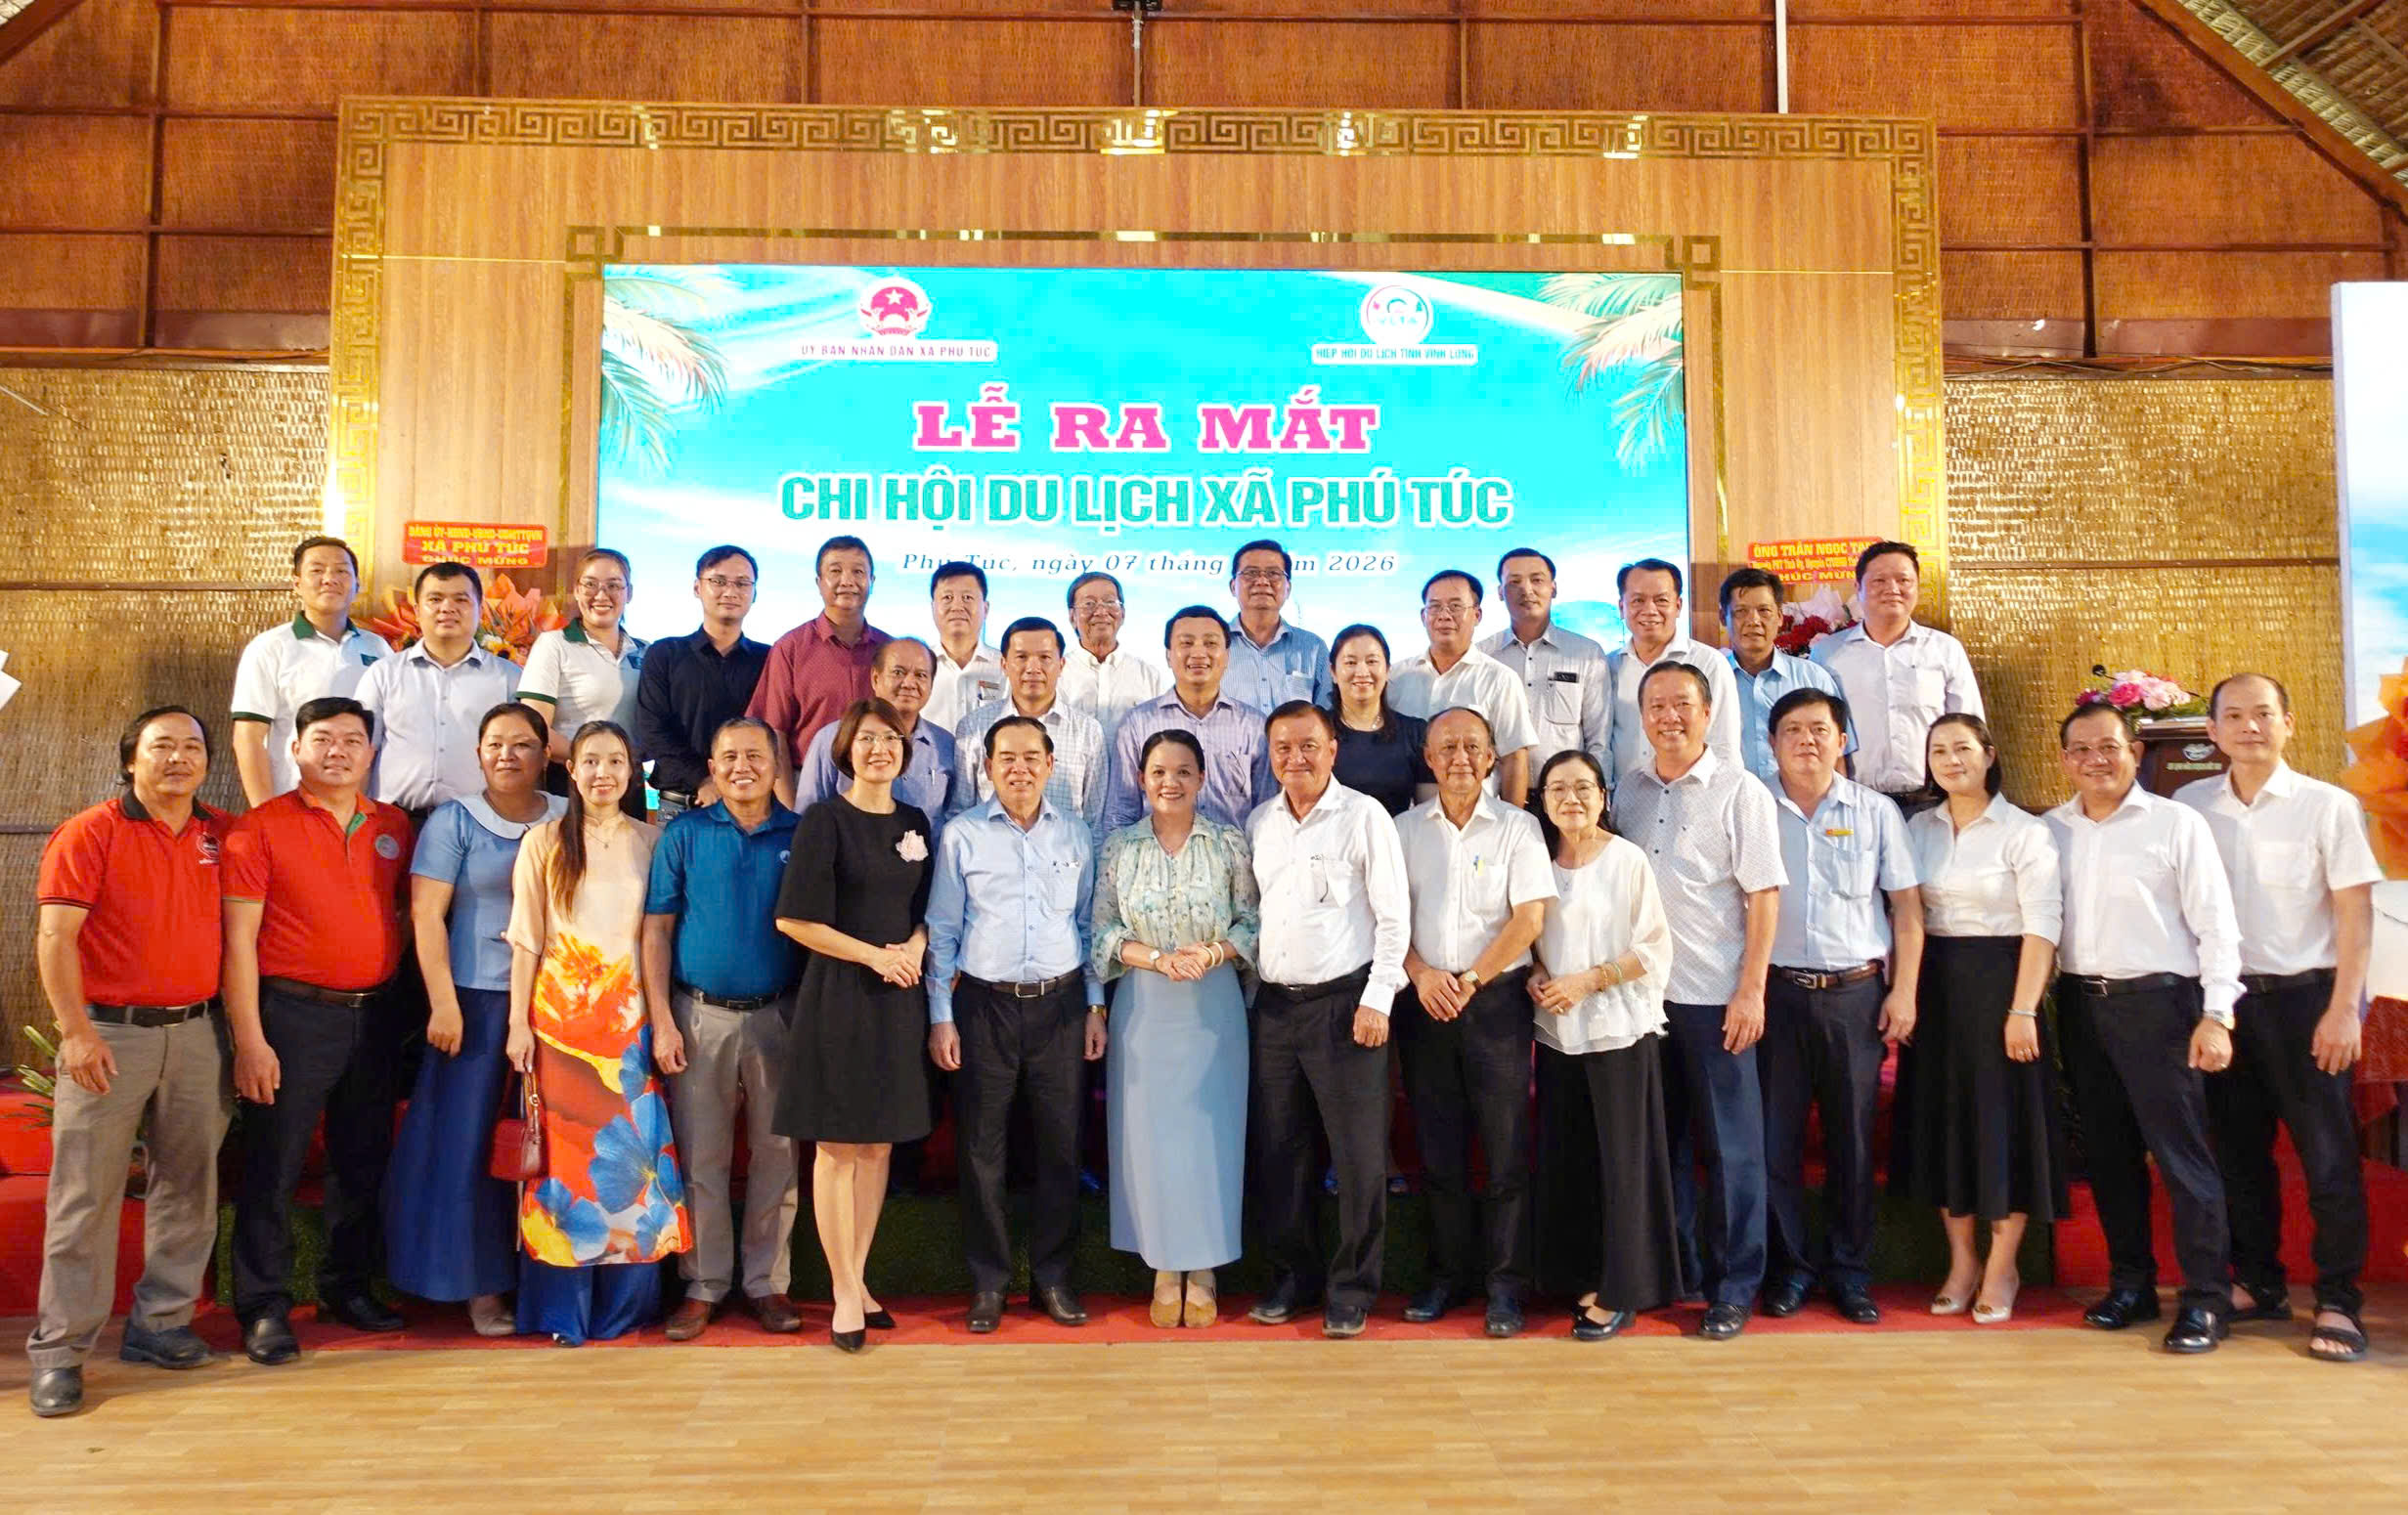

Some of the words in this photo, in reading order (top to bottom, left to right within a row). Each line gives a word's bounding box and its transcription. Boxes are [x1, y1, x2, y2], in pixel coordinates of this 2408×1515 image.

[917, 385, 1016, 447] LỄ
[1054, 407, 1166, 449] RA
[1202, 389, 1376, 450] MẮT
[782, 476, 868, 520] CHI
[886, 468, 971, 531] HỘI
[988, 479, 1058, 521] DU
[1075, 479, 1188, 532] LỊCH
[1204, 471, 1276, 523] XÃ
[1292, 471, 1395, 523] PHÚ
[1411, 471, 1508, 523] TÚC
[1032, 553, 1093, 575] ngày
[1106, 554, 1138, 570] 07
[1149, 553, 1224, 575] tháng
[1329, 555, 1395, 571] 2026
